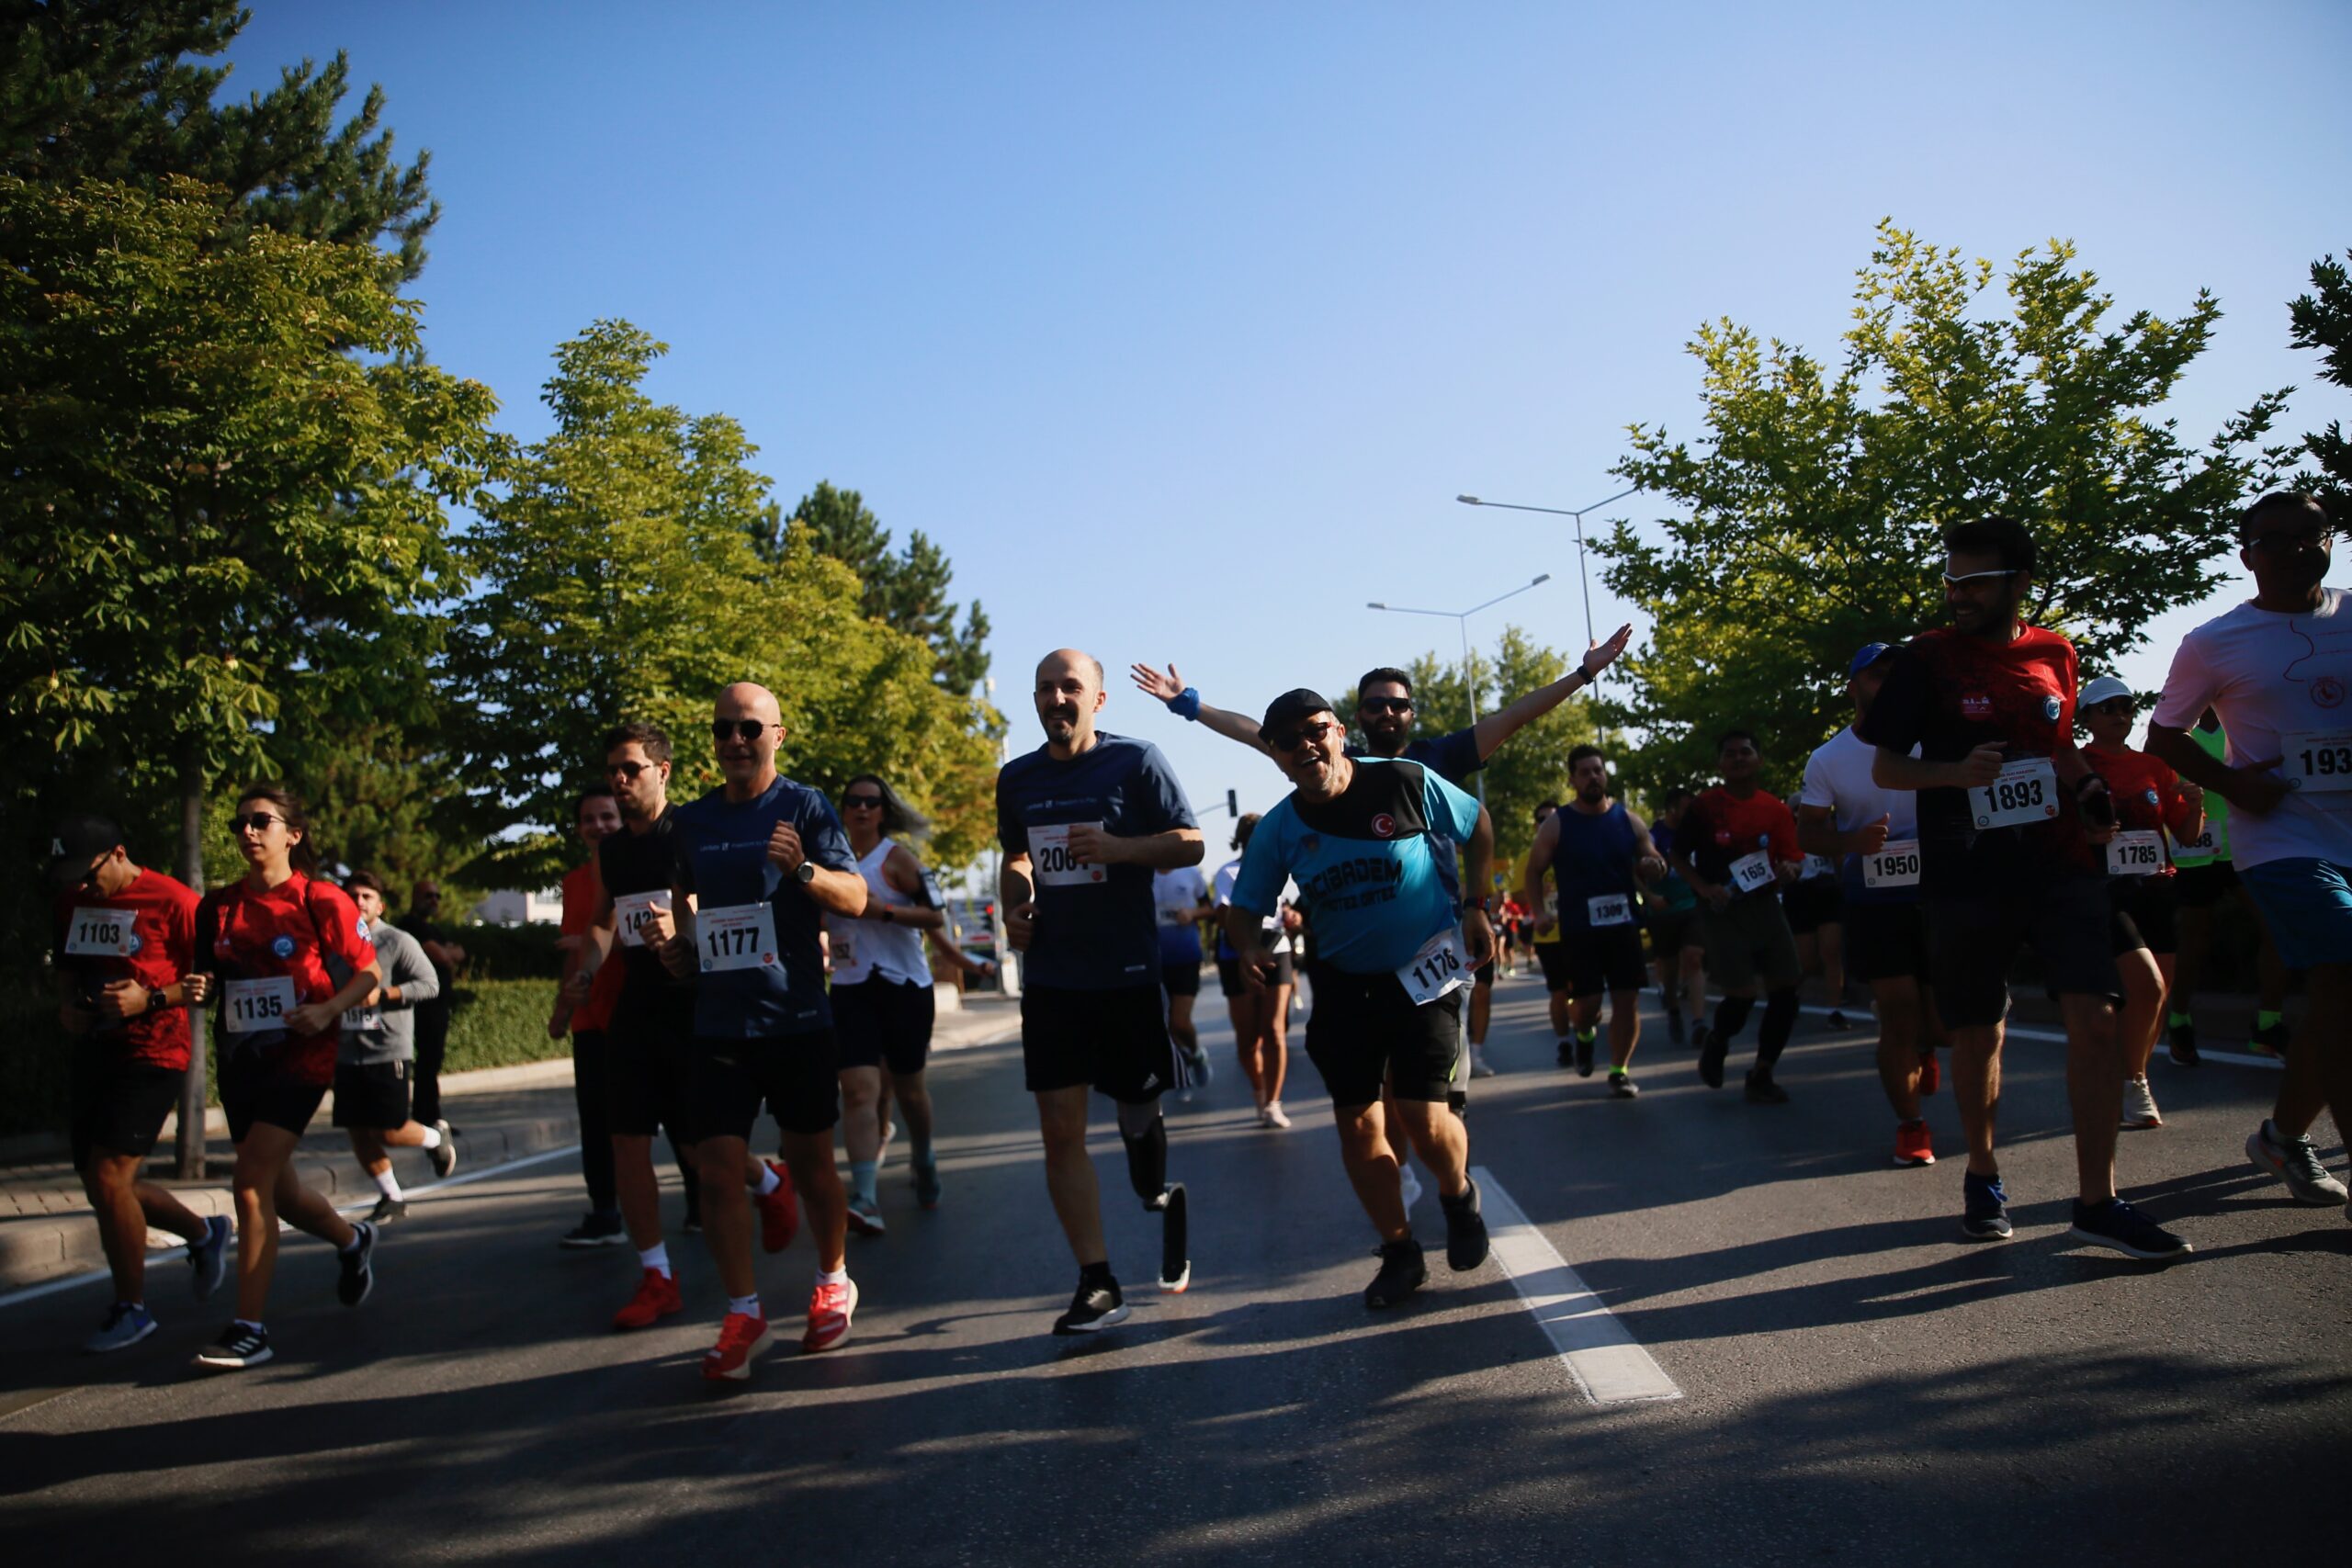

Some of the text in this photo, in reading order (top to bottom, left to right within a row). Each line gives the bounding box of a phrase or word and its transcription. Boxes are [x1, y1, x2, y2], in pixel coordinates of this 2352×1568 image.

[1984, 780, 2043, 813] 1893
[1873, 854, 1919, 876] 1950
[2118, 845, 2157, 864] 1785
[79, 921, 119, 943] 1103
[625, 911, 656, 934] 142
[707, 927, 760, 957] 1177
[233, 995, 283, 1020] 1135
